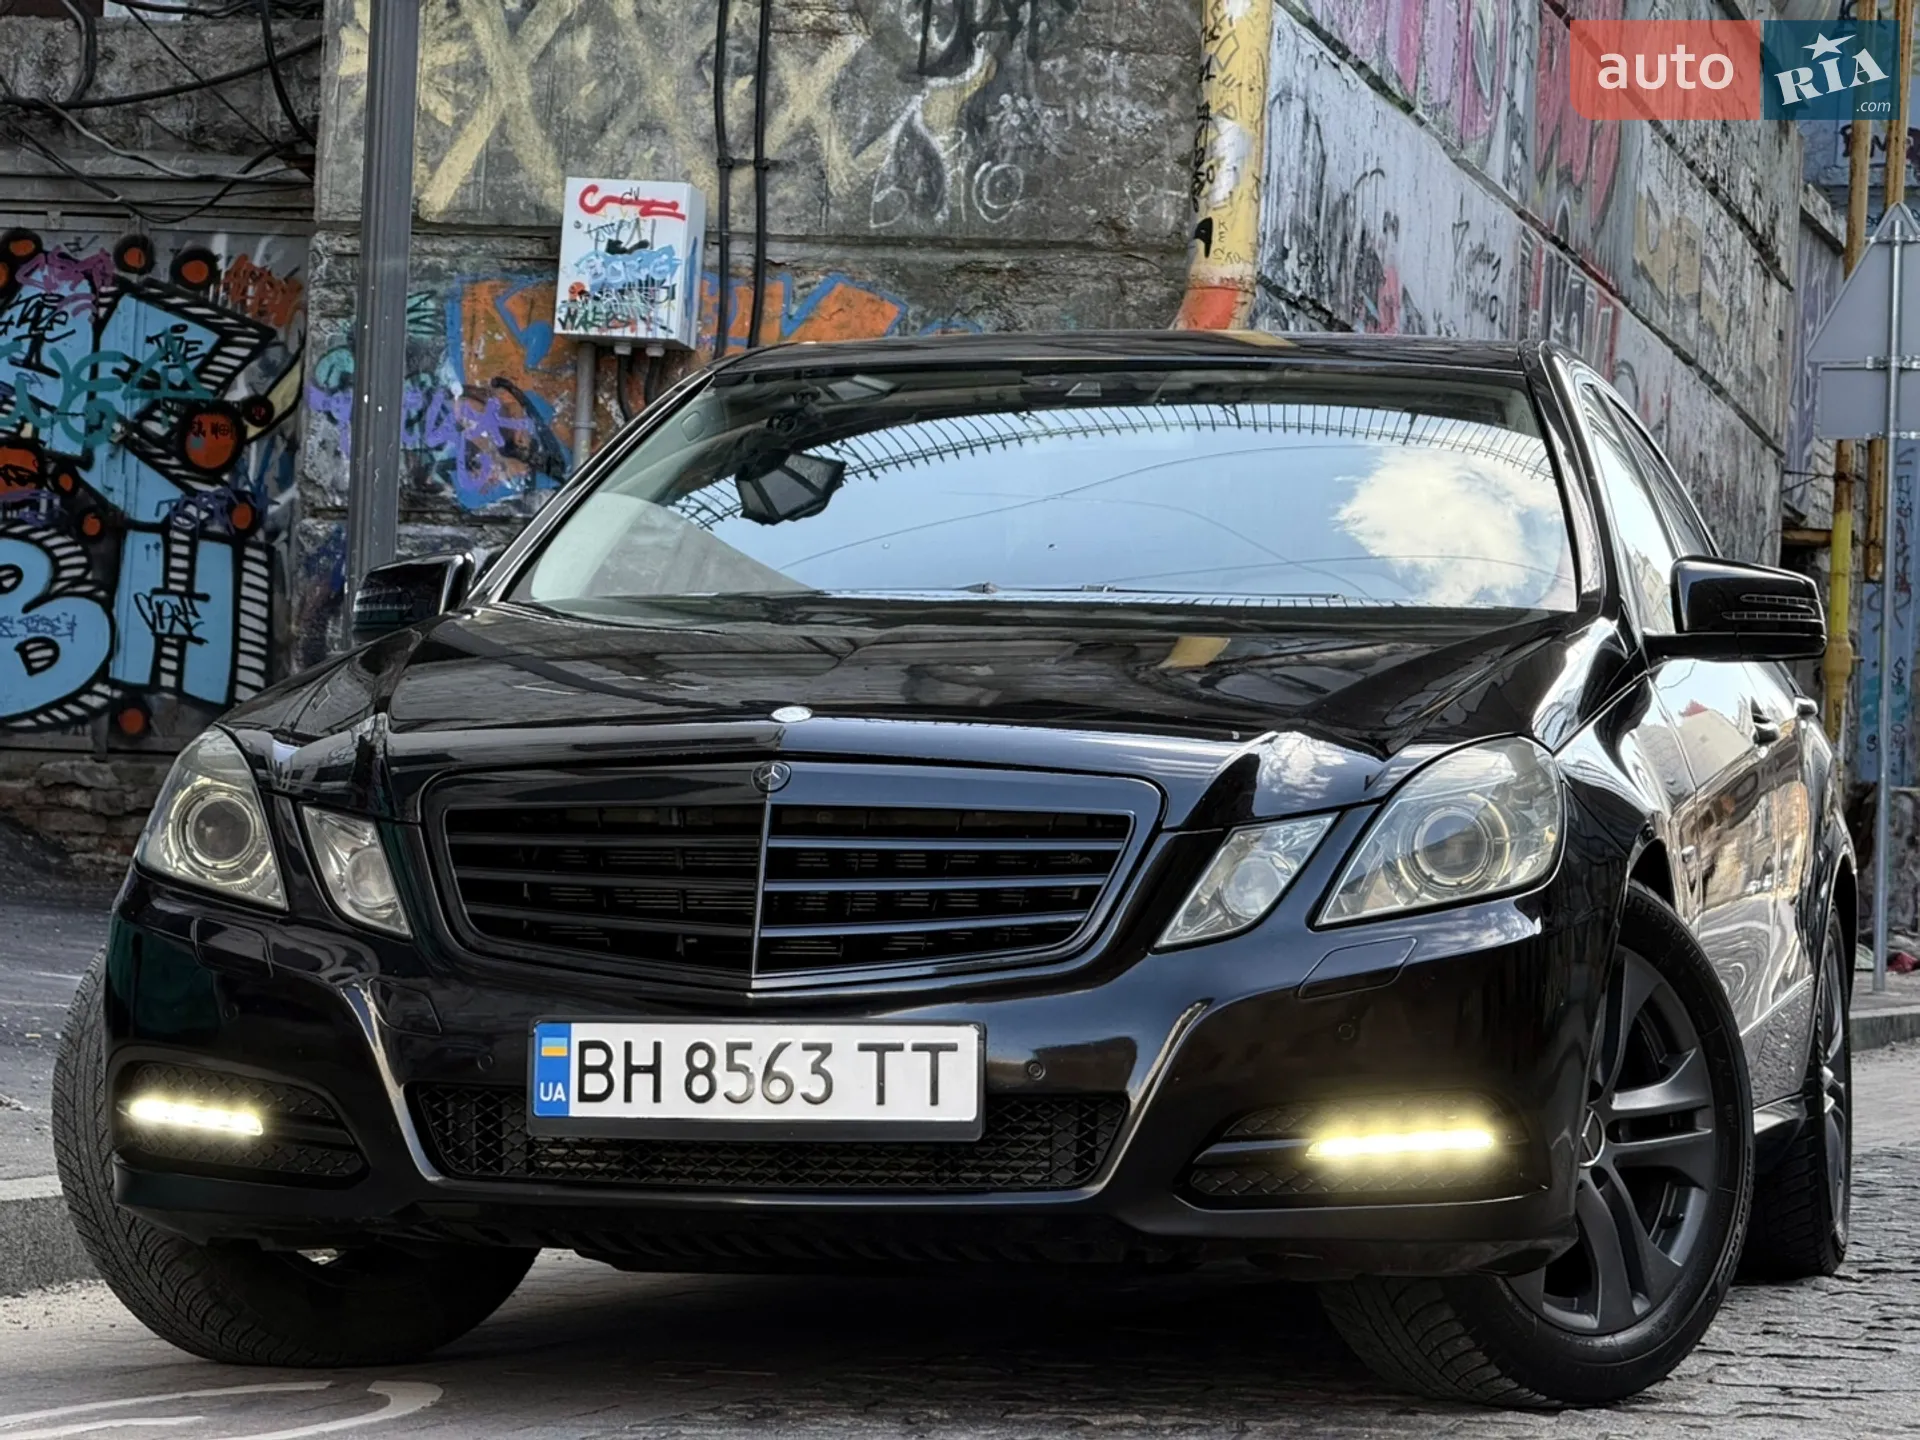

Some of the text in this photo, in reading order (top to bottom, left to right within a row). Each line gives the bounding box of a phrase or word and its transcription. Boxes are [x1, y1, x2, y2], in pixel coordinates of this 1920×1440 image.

[540, 1082, 566, 1102] UA
[577, 1040, 959, 1106] BH 8563 TT
